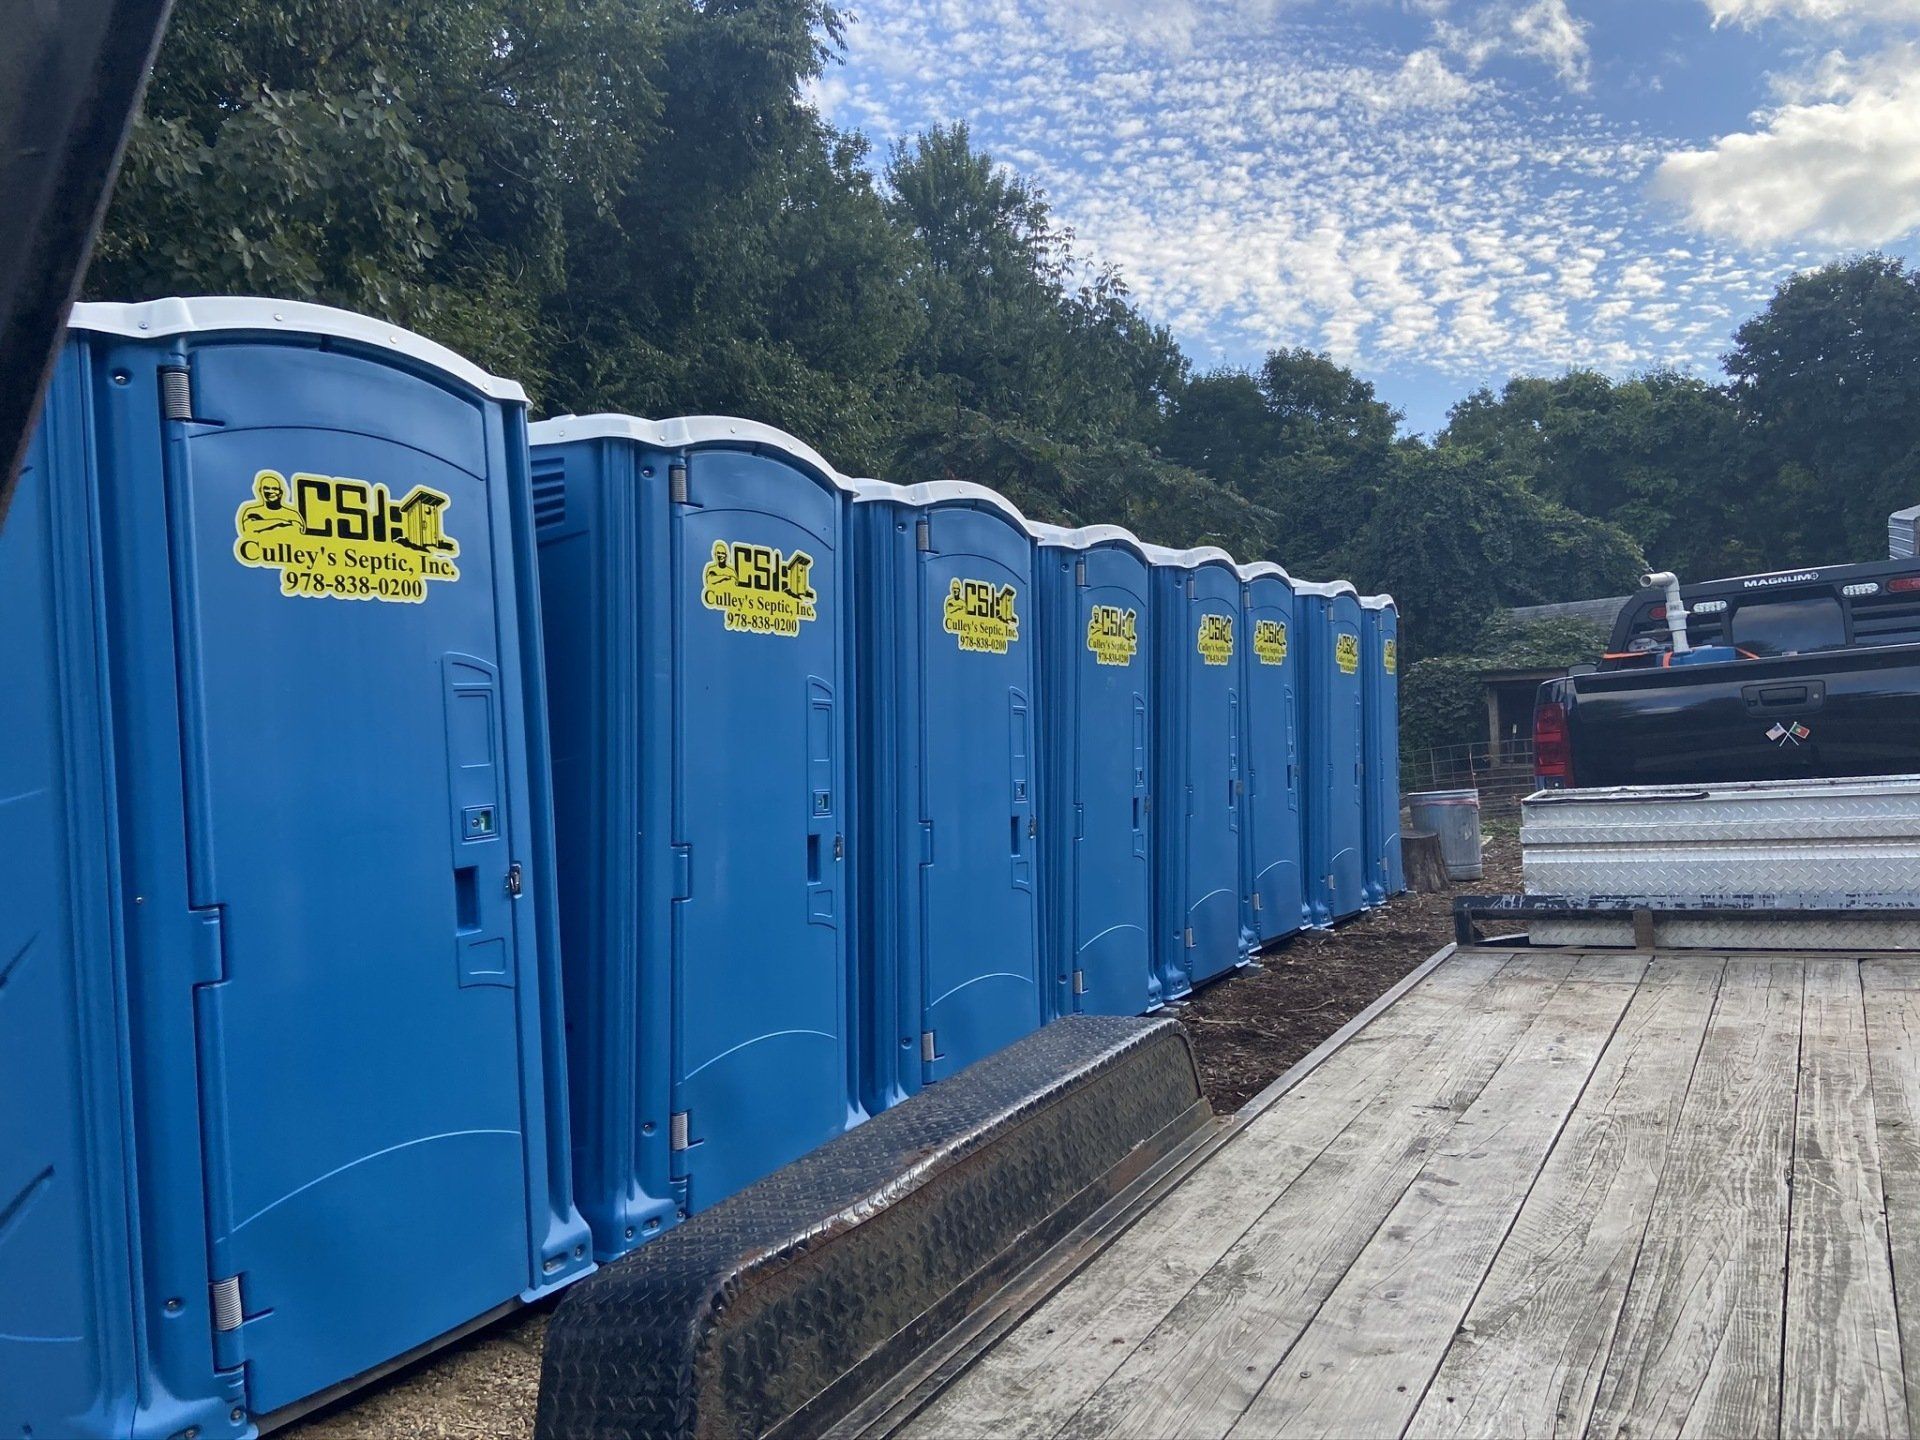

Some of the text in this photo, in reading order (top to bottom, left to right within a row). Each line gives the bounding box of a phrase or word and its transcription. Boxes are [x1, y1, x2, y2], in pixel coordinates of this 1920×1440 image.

[240, 540, 456, 576] Culley's Septic, Inc.
[286, 571, 422, 598] 978-838-0200
[1743, 574, 1811, 588] MAGNUM
[704, 590, 815, 617] Culley's Septic, Inc.
[727, 612, 798, 632] 978-838-0200
[945, 618, 978, 635] Culley's
